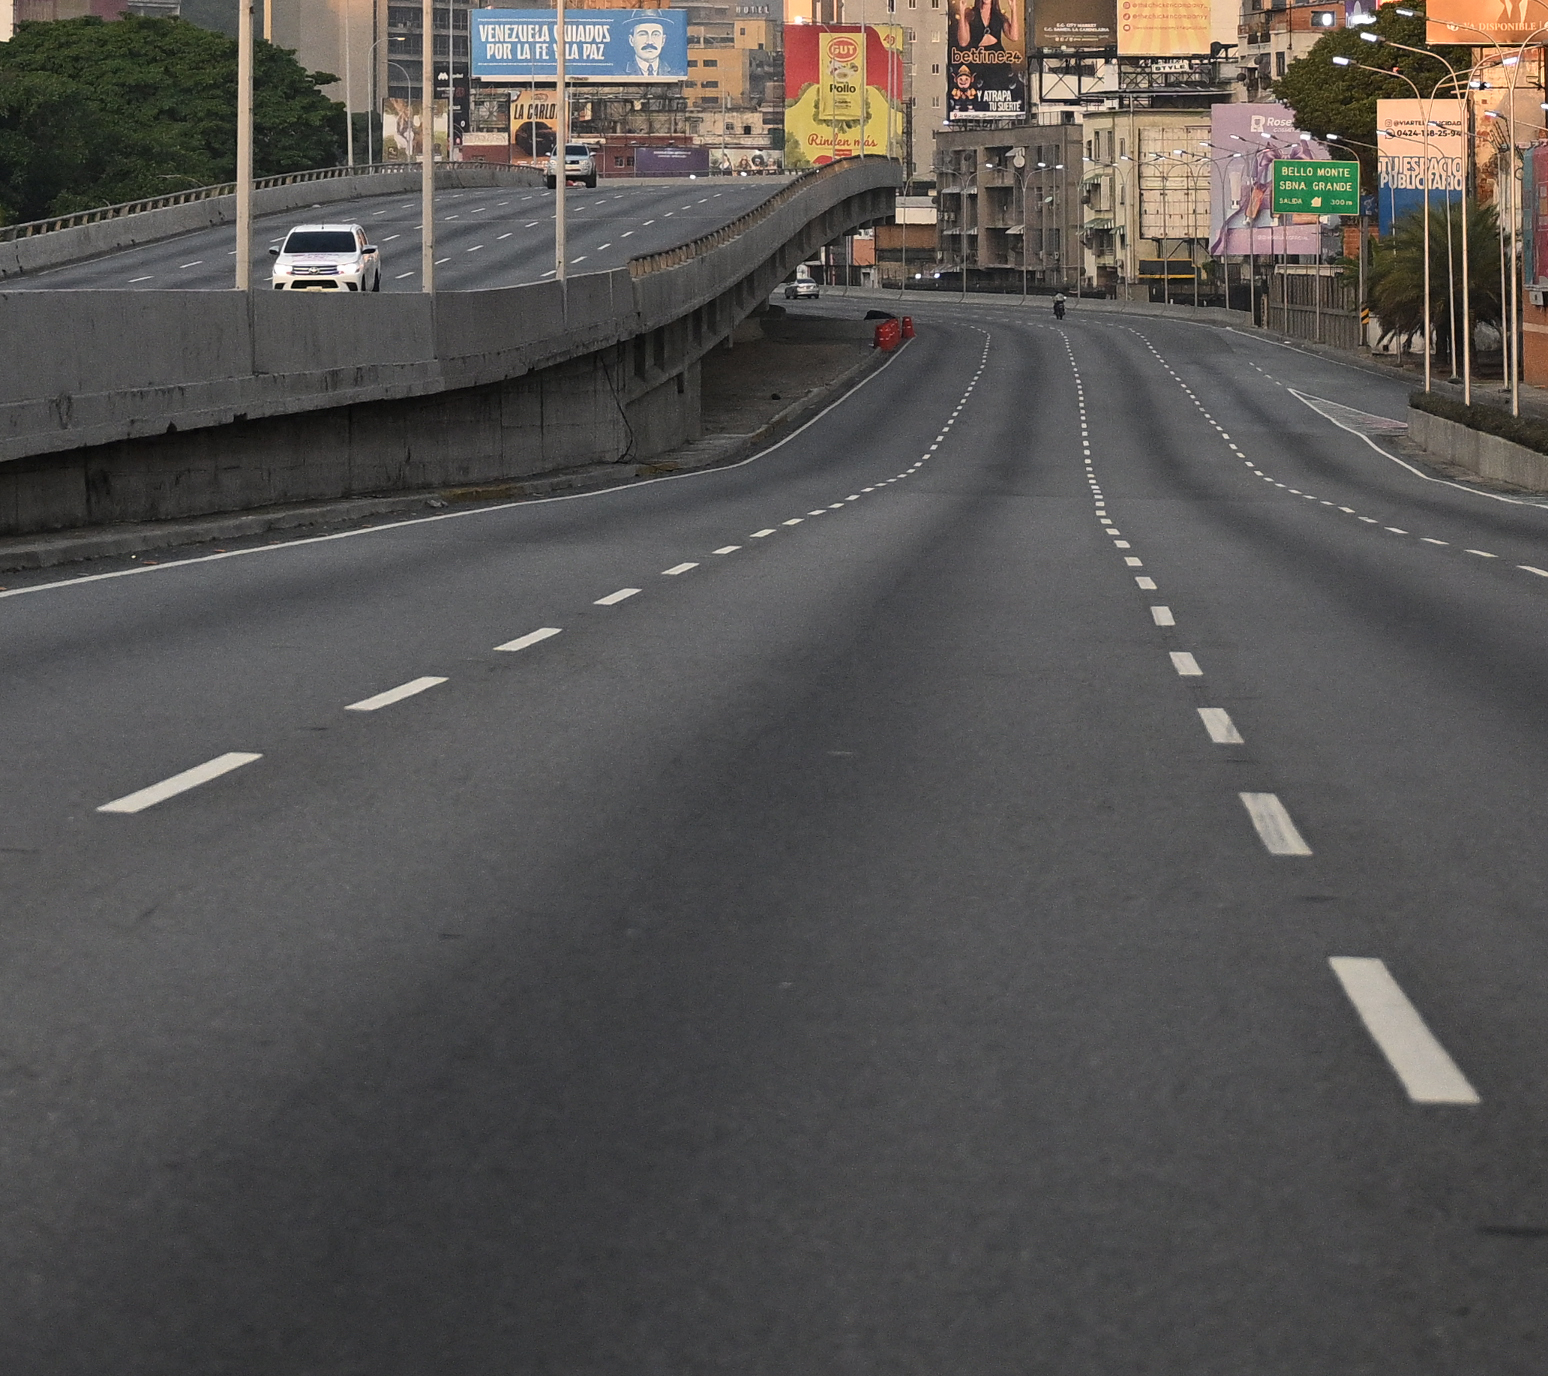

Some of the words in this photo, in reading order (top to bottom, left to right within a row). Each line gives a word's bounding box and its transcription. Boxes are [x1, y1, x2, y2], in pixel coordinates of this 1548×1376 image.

[735, 5, 770, 14] HOTEL
[1478, 21, 1537, 31] DISPONIBLE
[478, 24, 550, 43] VENEZUELA
[486, 43, 514, 60] POR
[516, 44, 532, 60] LA
[534, 43, 550, 60] FE
[565, 44, 580, 60] LA
[582, 44, 605, 60] PAZ
[830, 45, 855, 55] GUT
[951, 47, 1023, 64] betfine24
[829, 84, 857, 94] Pollo
[976, 91, 982, 102] Y
[983, 90, 1012, 102] ATRAPA
[988, 102, 997, 112] TU
[997, 101, 1021, 112] SUERTE
[513, 104, 526, 121] LA
[807, 133, 852, 147] Rinden
[853, 134, 878, 147] más
[1281, 166, 1313, 177] BELLO
[1317, 167, 1351, 178] MONTE
[1312, 181, 1353, 192] GRANDE
[1279, 197, 1303, 205] SALIDA
